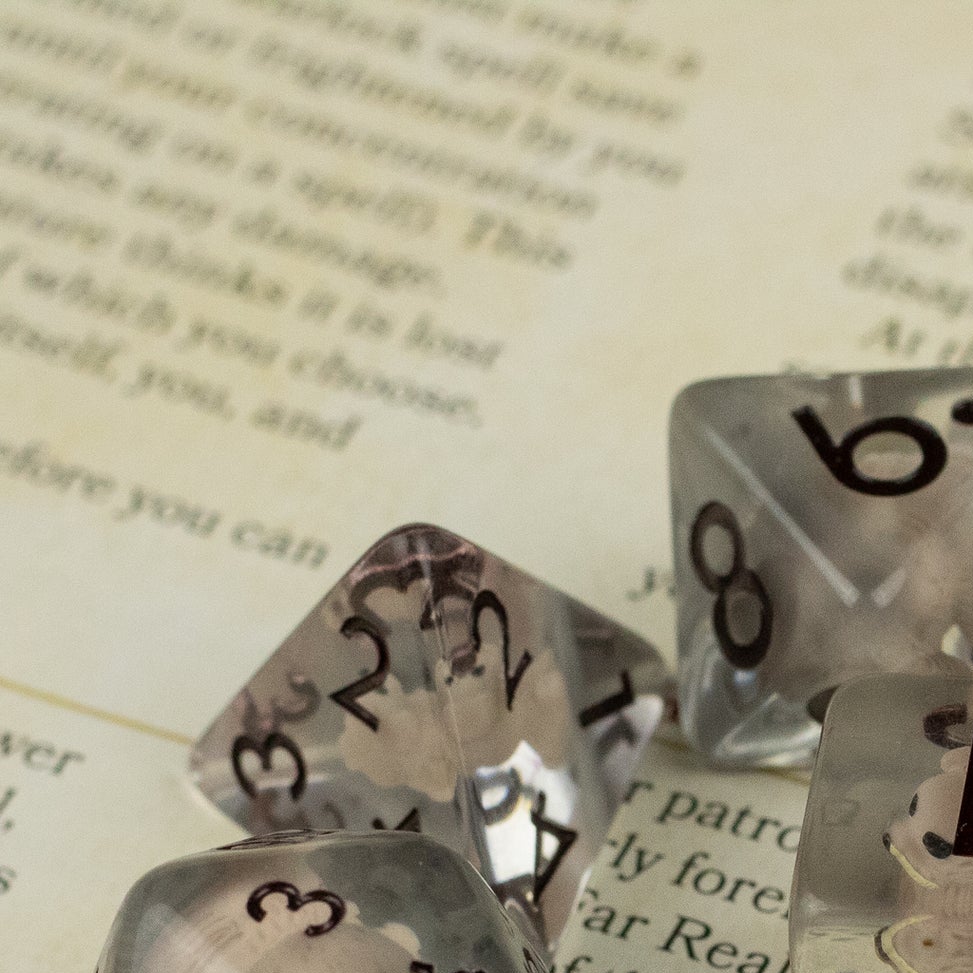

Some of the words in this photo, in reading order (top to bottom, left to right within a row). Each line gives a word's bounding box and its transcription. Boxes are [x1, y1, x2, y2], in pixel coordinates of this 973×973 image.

[112, 485, 225, 540] you
[230, 518, 330, 572] can
[690, 500, 773, 668] 8
[330, 615, 390, 730] 2
[233, 733, 305, 800] 3
[658, 790, 802, 855] patro
[247, 882, 345, 937] 3
